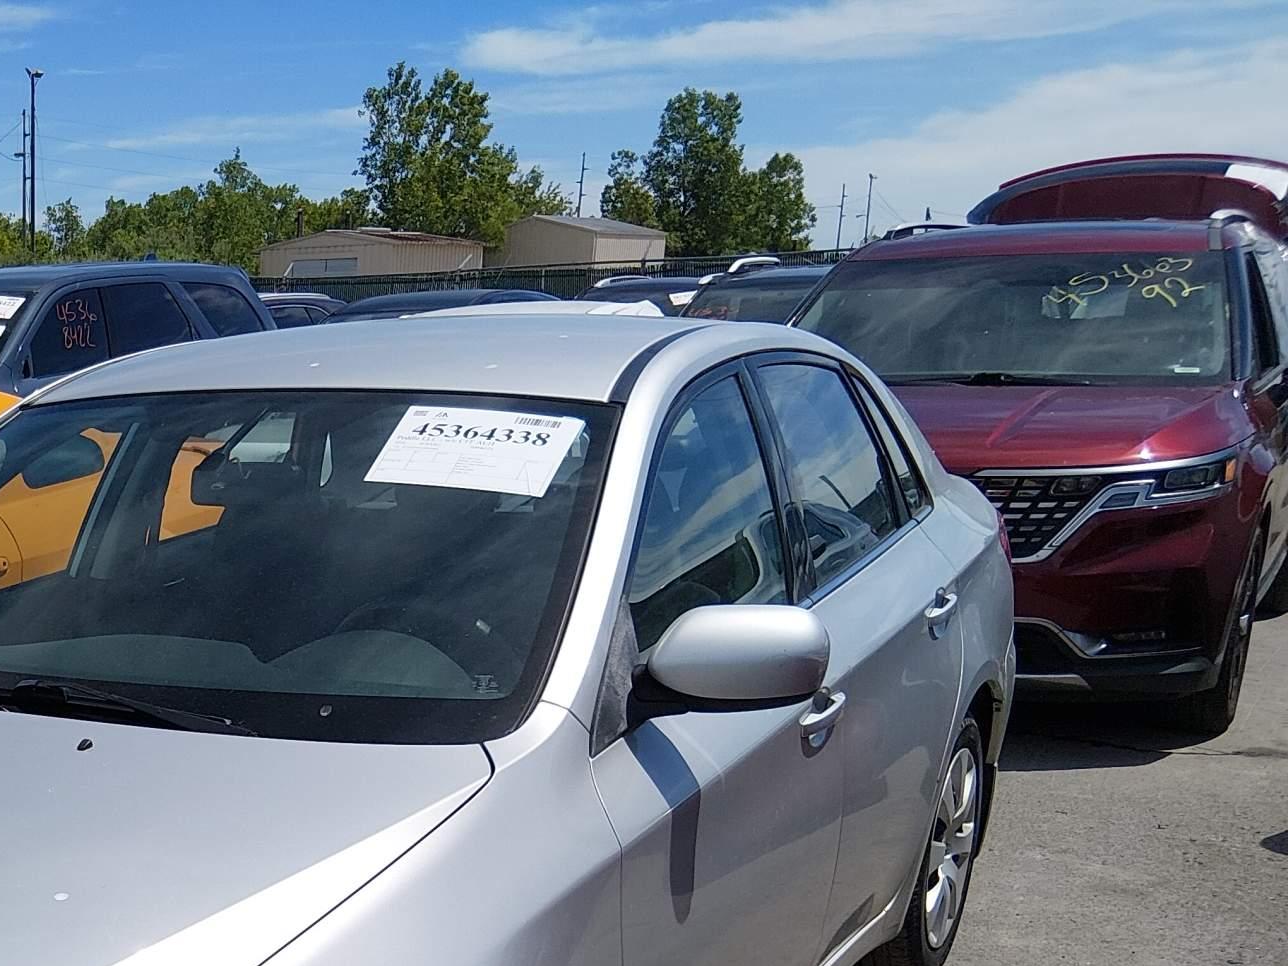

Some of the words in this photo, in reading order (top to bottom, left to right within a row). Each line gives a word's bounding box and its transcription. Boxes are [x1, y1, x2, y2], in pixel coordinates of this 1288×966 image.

[1141, 276, 1206, 308] 92
[56, 299, 98, 322] 4536
[412, 422, 552, 447] 45364338
